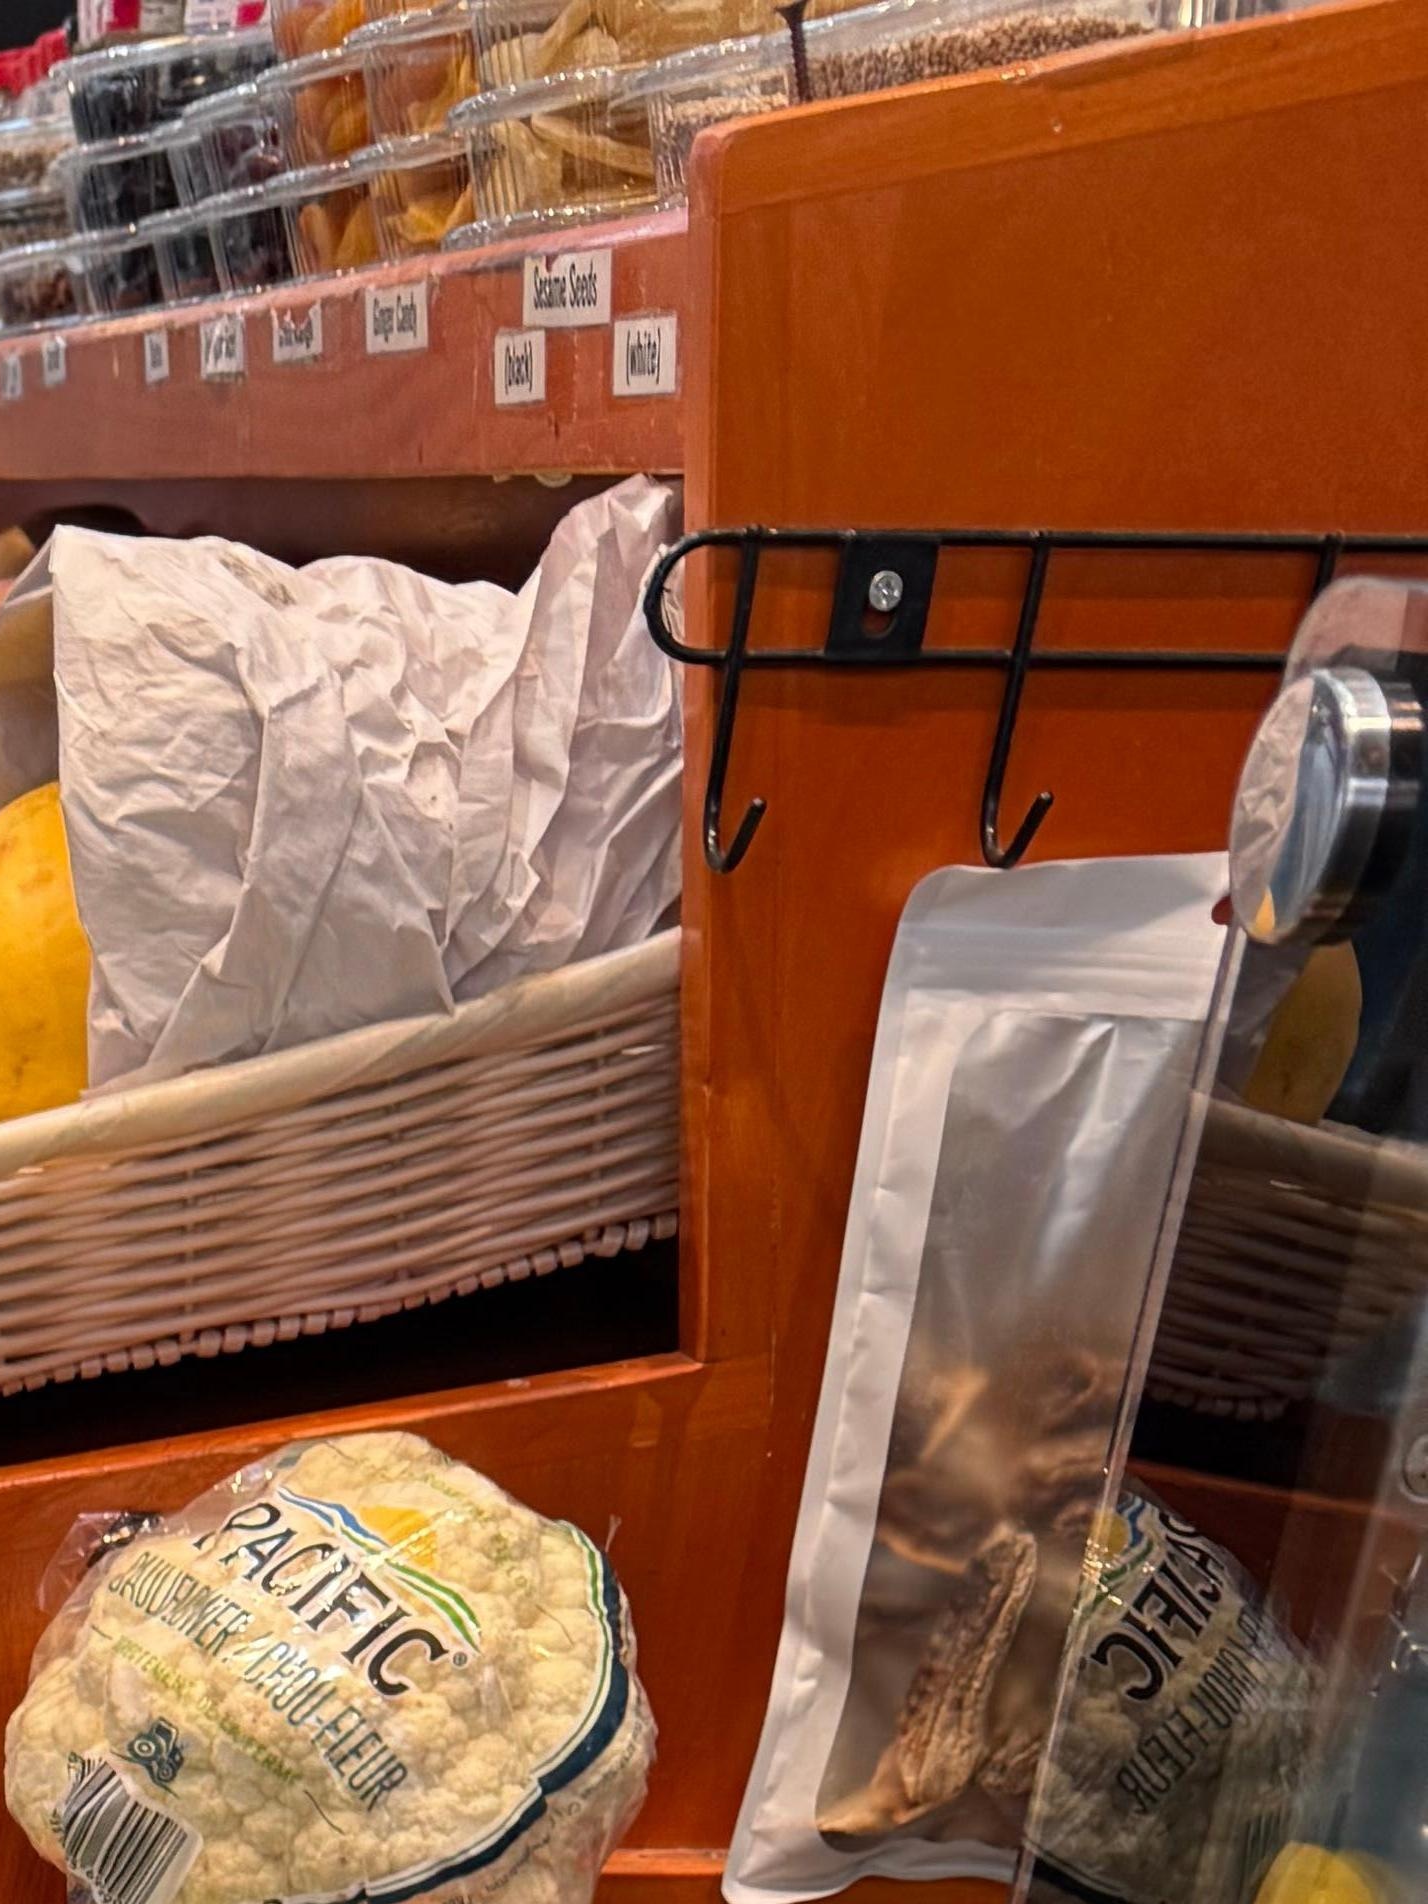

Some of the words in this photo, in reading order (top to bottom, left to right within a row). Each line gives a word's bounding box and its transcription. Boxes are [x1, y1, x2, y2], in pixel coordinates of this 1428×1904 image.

[533, 264, 567, 310] Sesame
[569, 257, 598, 309] Seeds
[504, 340, 533, 395] (black)
[626, 328, 662, 387] (white)
[192, 1502, 450, 1697] PACIFIC
[244, 1641, 410, 1812] CHOU-FLEUR
